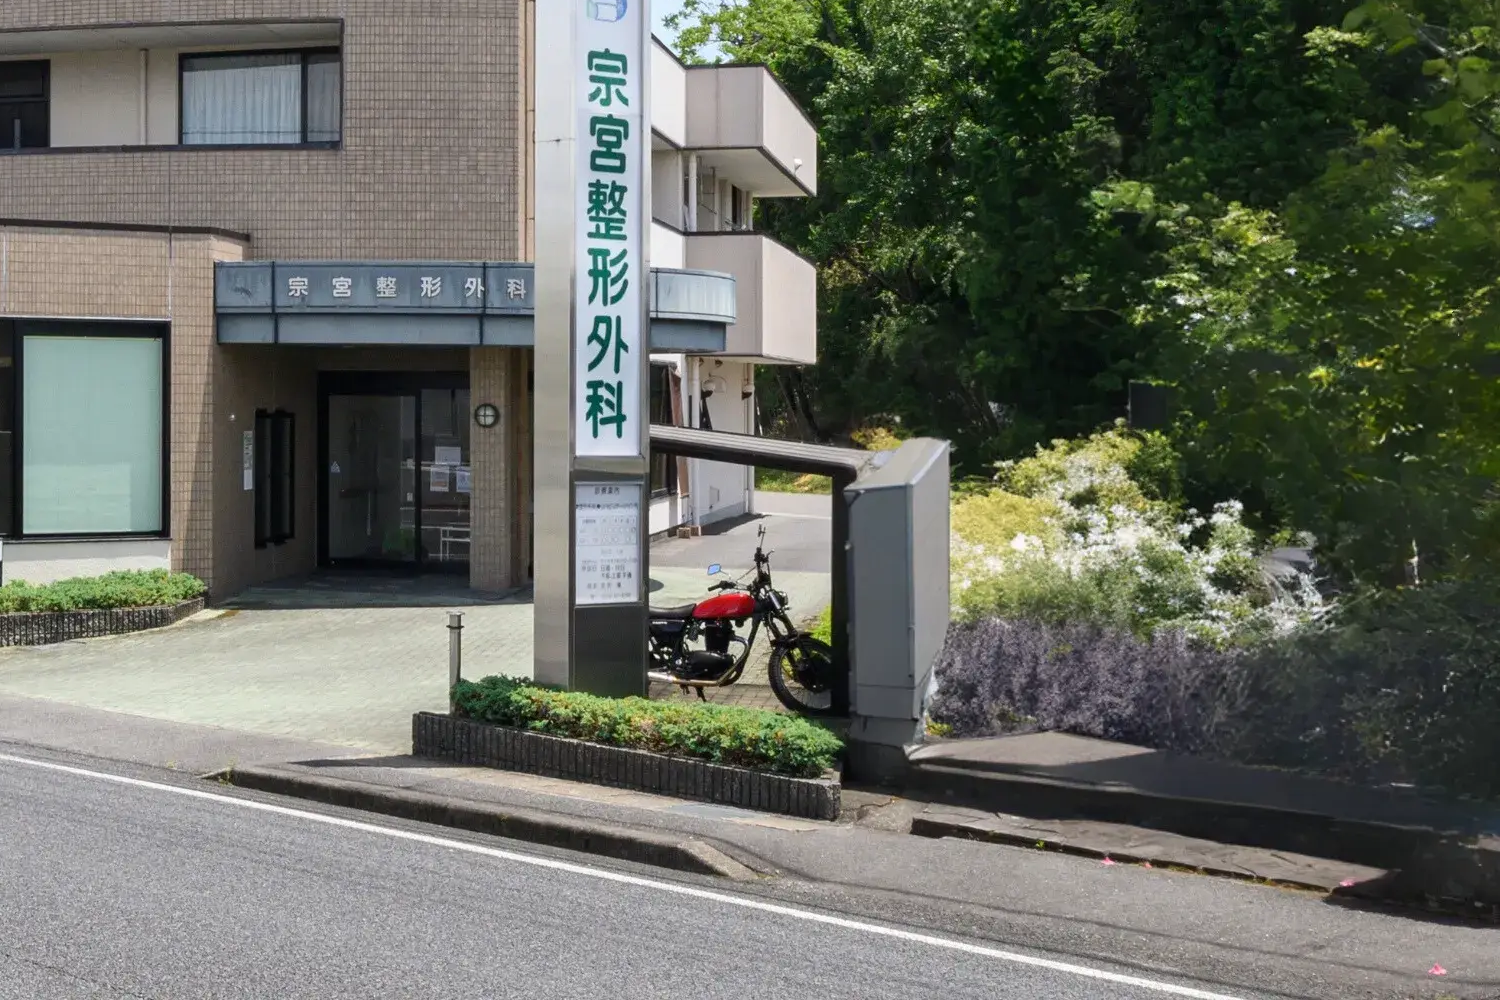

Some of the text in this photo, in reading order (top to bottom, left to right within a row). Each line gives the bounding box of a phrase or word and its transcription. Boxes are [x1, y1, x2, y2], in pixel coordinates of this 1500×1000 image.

[288, 276, 527, 299] 宗宮整形外科
[585, 48, 629, 440] 宗宮整形外科
